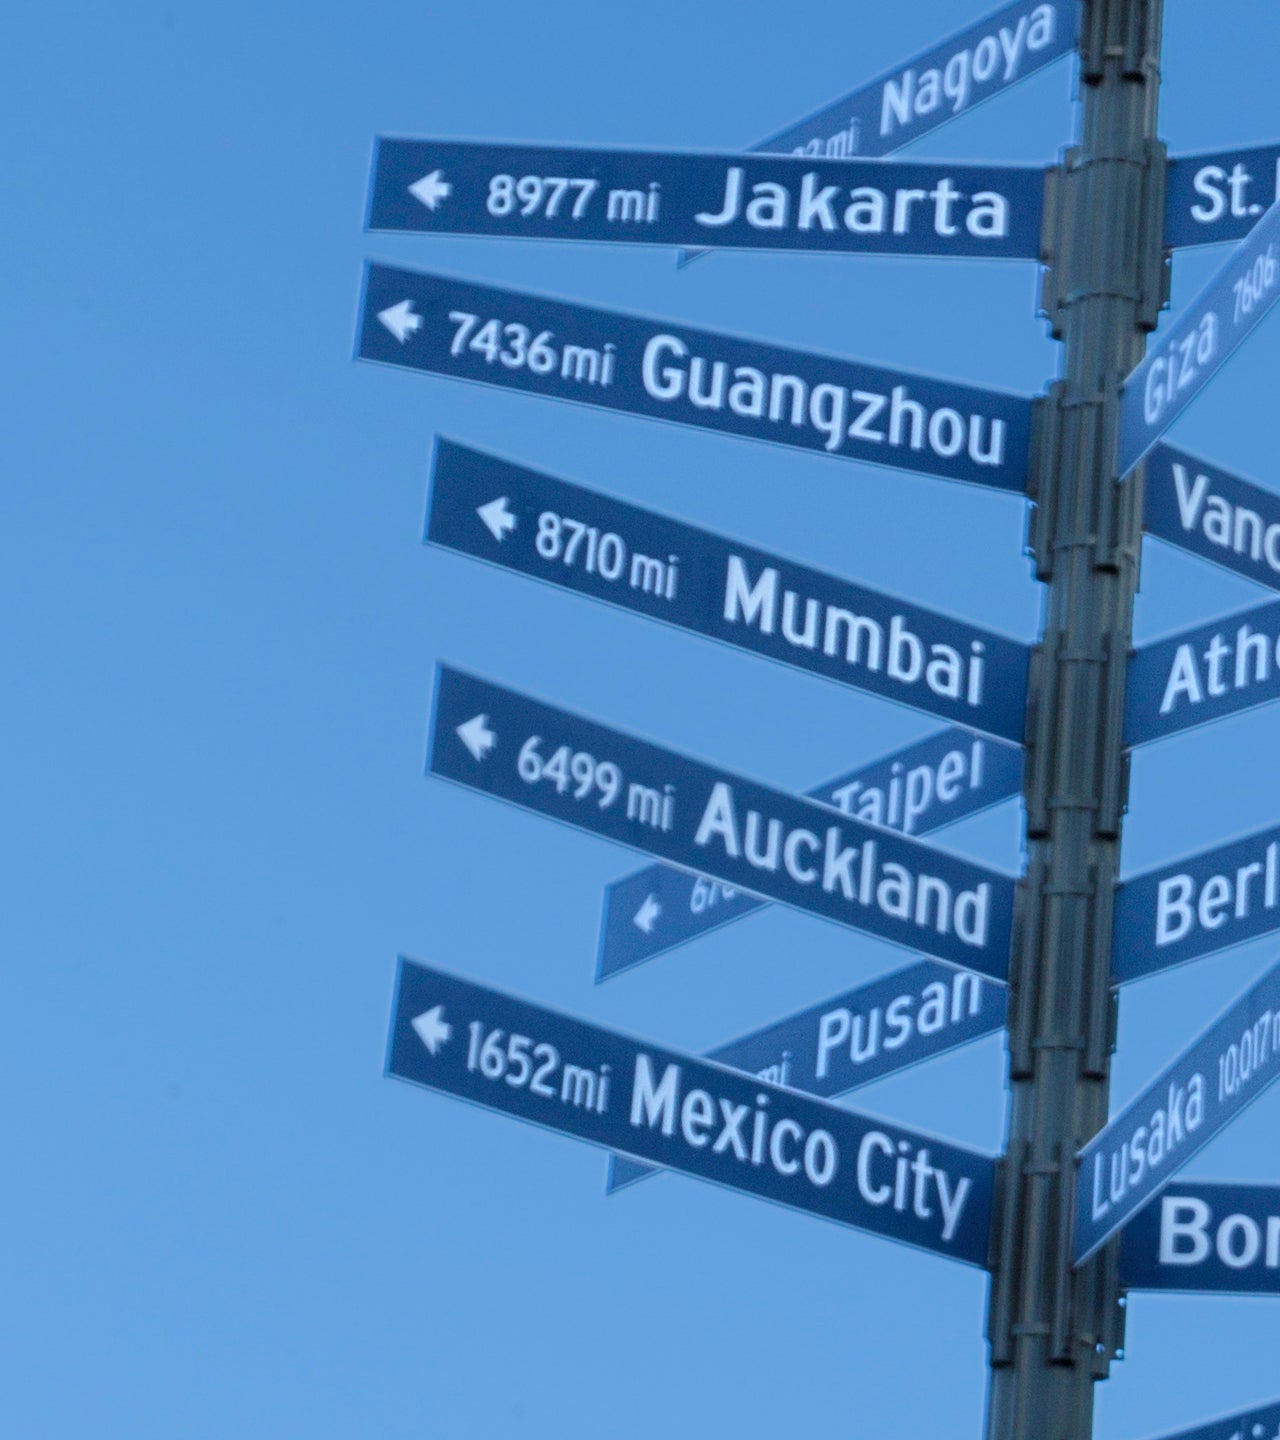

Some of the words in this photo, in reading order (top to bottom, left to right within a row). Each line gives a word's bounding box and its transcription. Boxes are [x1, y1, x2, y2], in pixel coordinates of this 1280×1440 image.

[879, 1, 1056, 136] Nagoya
[486, 175, 596, 220] 8977
[607, 182, 660, 223] mi
[694, 167, 1010, 238] Jakarta
[1190, 163, 1263, 222] St.
[447, 311, 555, 372] 7436
[561, 342, 614, 386] mi
[641, 334, 1006, 468] Guangzhou
[1144, 311, 1217, 423] Giza
[1232, 249, 1275, 323] 7606
[534, 511, 622, 580] 8710
[630, 554, 679, 599] mi
[723, 555, 984, 707] Mumbai
[517, 735, 620, 809] 6499
[626, 784, 675, 830] mi
[695, 782, 991, 947] Auckland
[816, 972, 980, 1079] Pusan
[466, 1020, 562, 1095] 1652
[561, 1064, 611, 1114] mi
[629, 1053, 837, 1186] Mexico
[856, 1138, 972, 1241] City
[1091, 1073, 1205, 1222] Lusaka
[1217, 1017, 1269, 1102] 10,017
